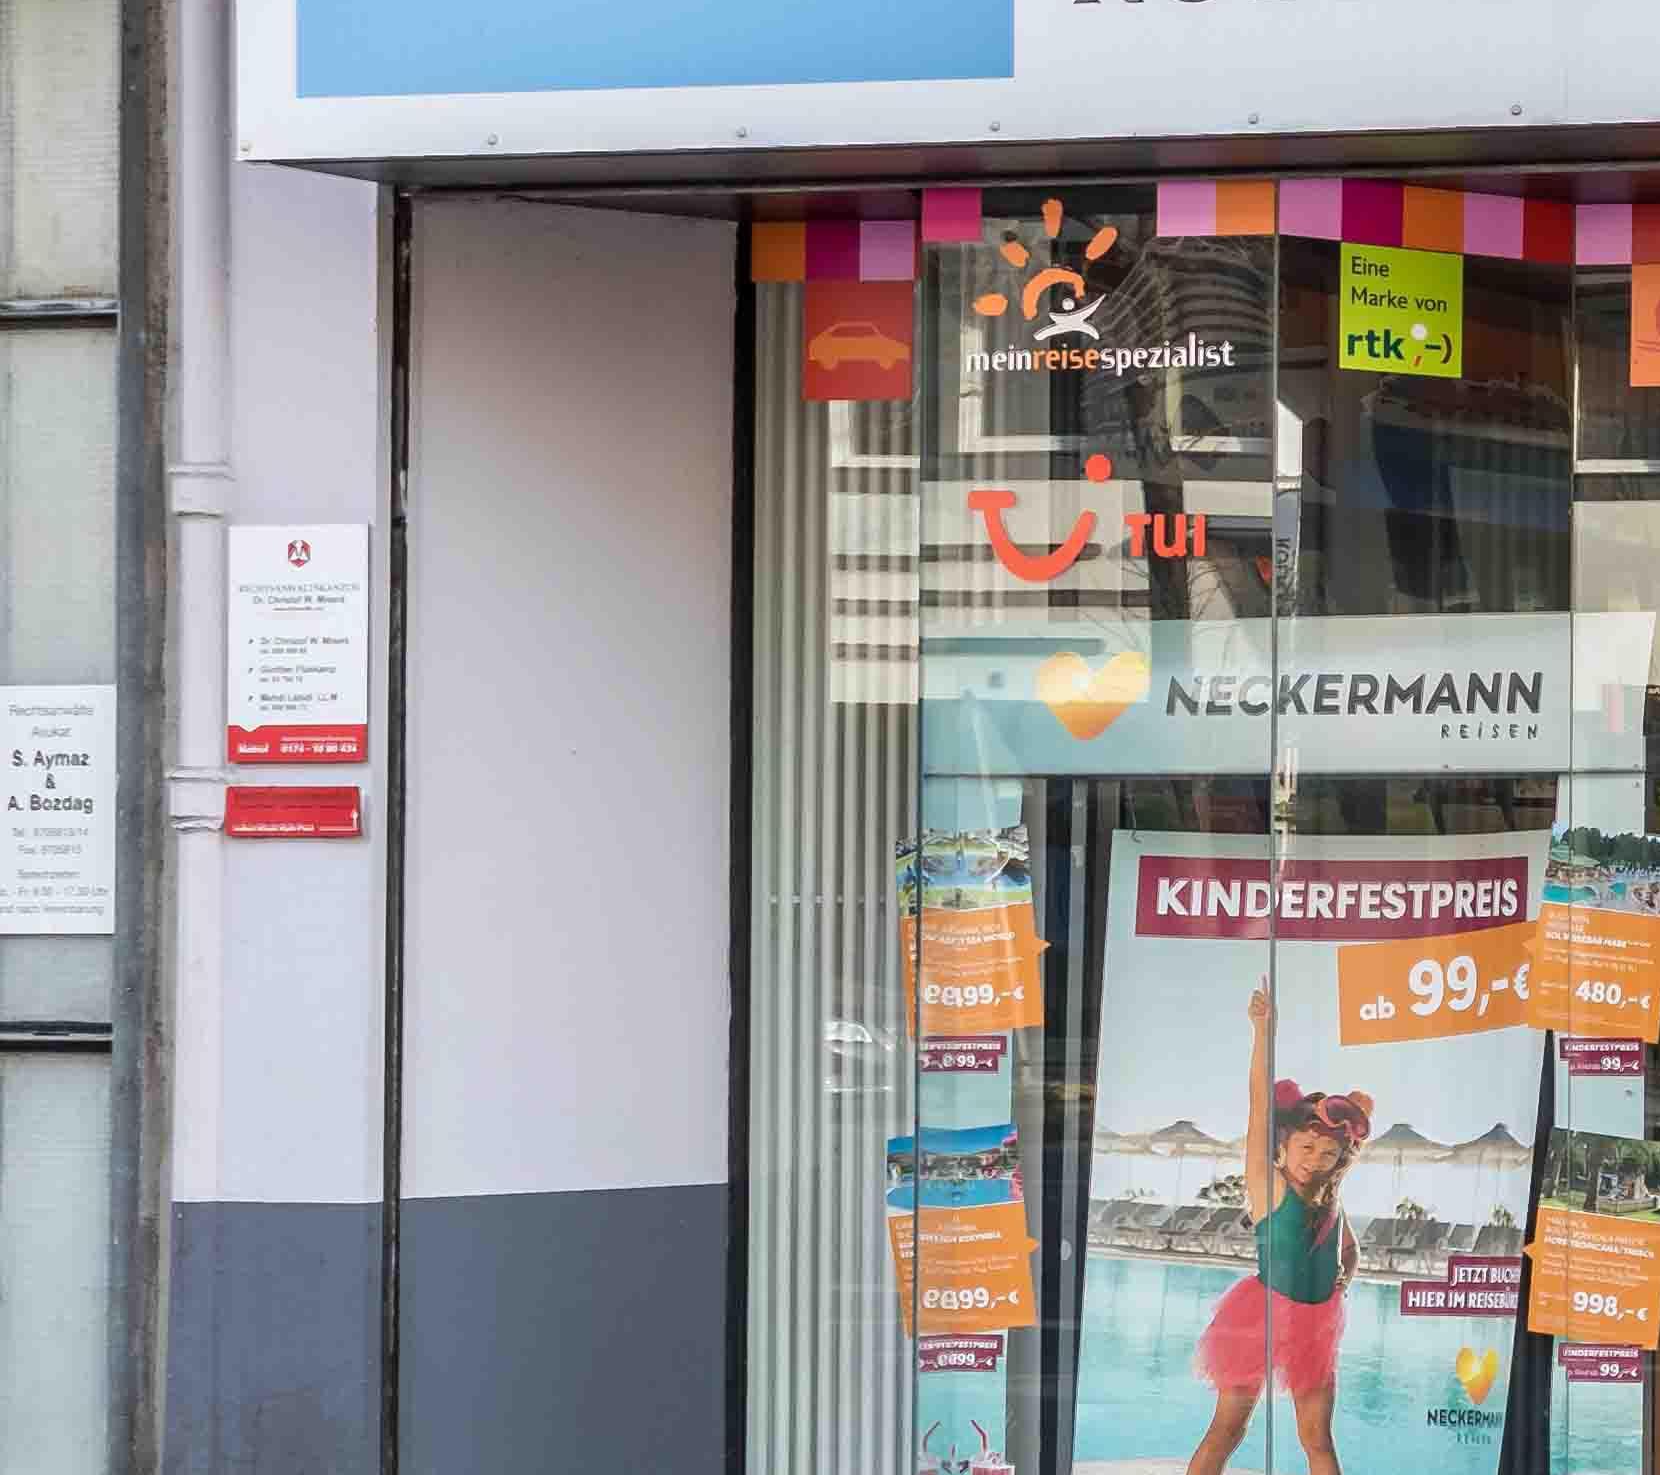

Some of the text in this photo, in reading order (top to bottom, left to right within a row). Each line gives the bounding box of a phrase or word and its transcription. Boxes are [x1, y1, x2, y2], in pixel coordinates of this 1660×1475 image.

[1351, 256, 1390, 279] Eine
[1351, 285, 1449, 313] Marke von
[964, 331, 1237, 379] meinreisespezialist
[1346, 326, 1405, 362] rtk
[1125, 514, 1206, 558] TUI
[1166, 670, 1544, 717] NECKERMANN
[11, 748, 91, 770] S. Aymaz
[7, 794, 95, 815] A. Bozdag
[1156, 875, 1519, 921] KINDERFESTPREIS
[1359, 989, 1396, 1022] ab
[1451, 1265, 1488, 1287] JETZT
[1407, 1289, 1466, 1309] HIER IM
